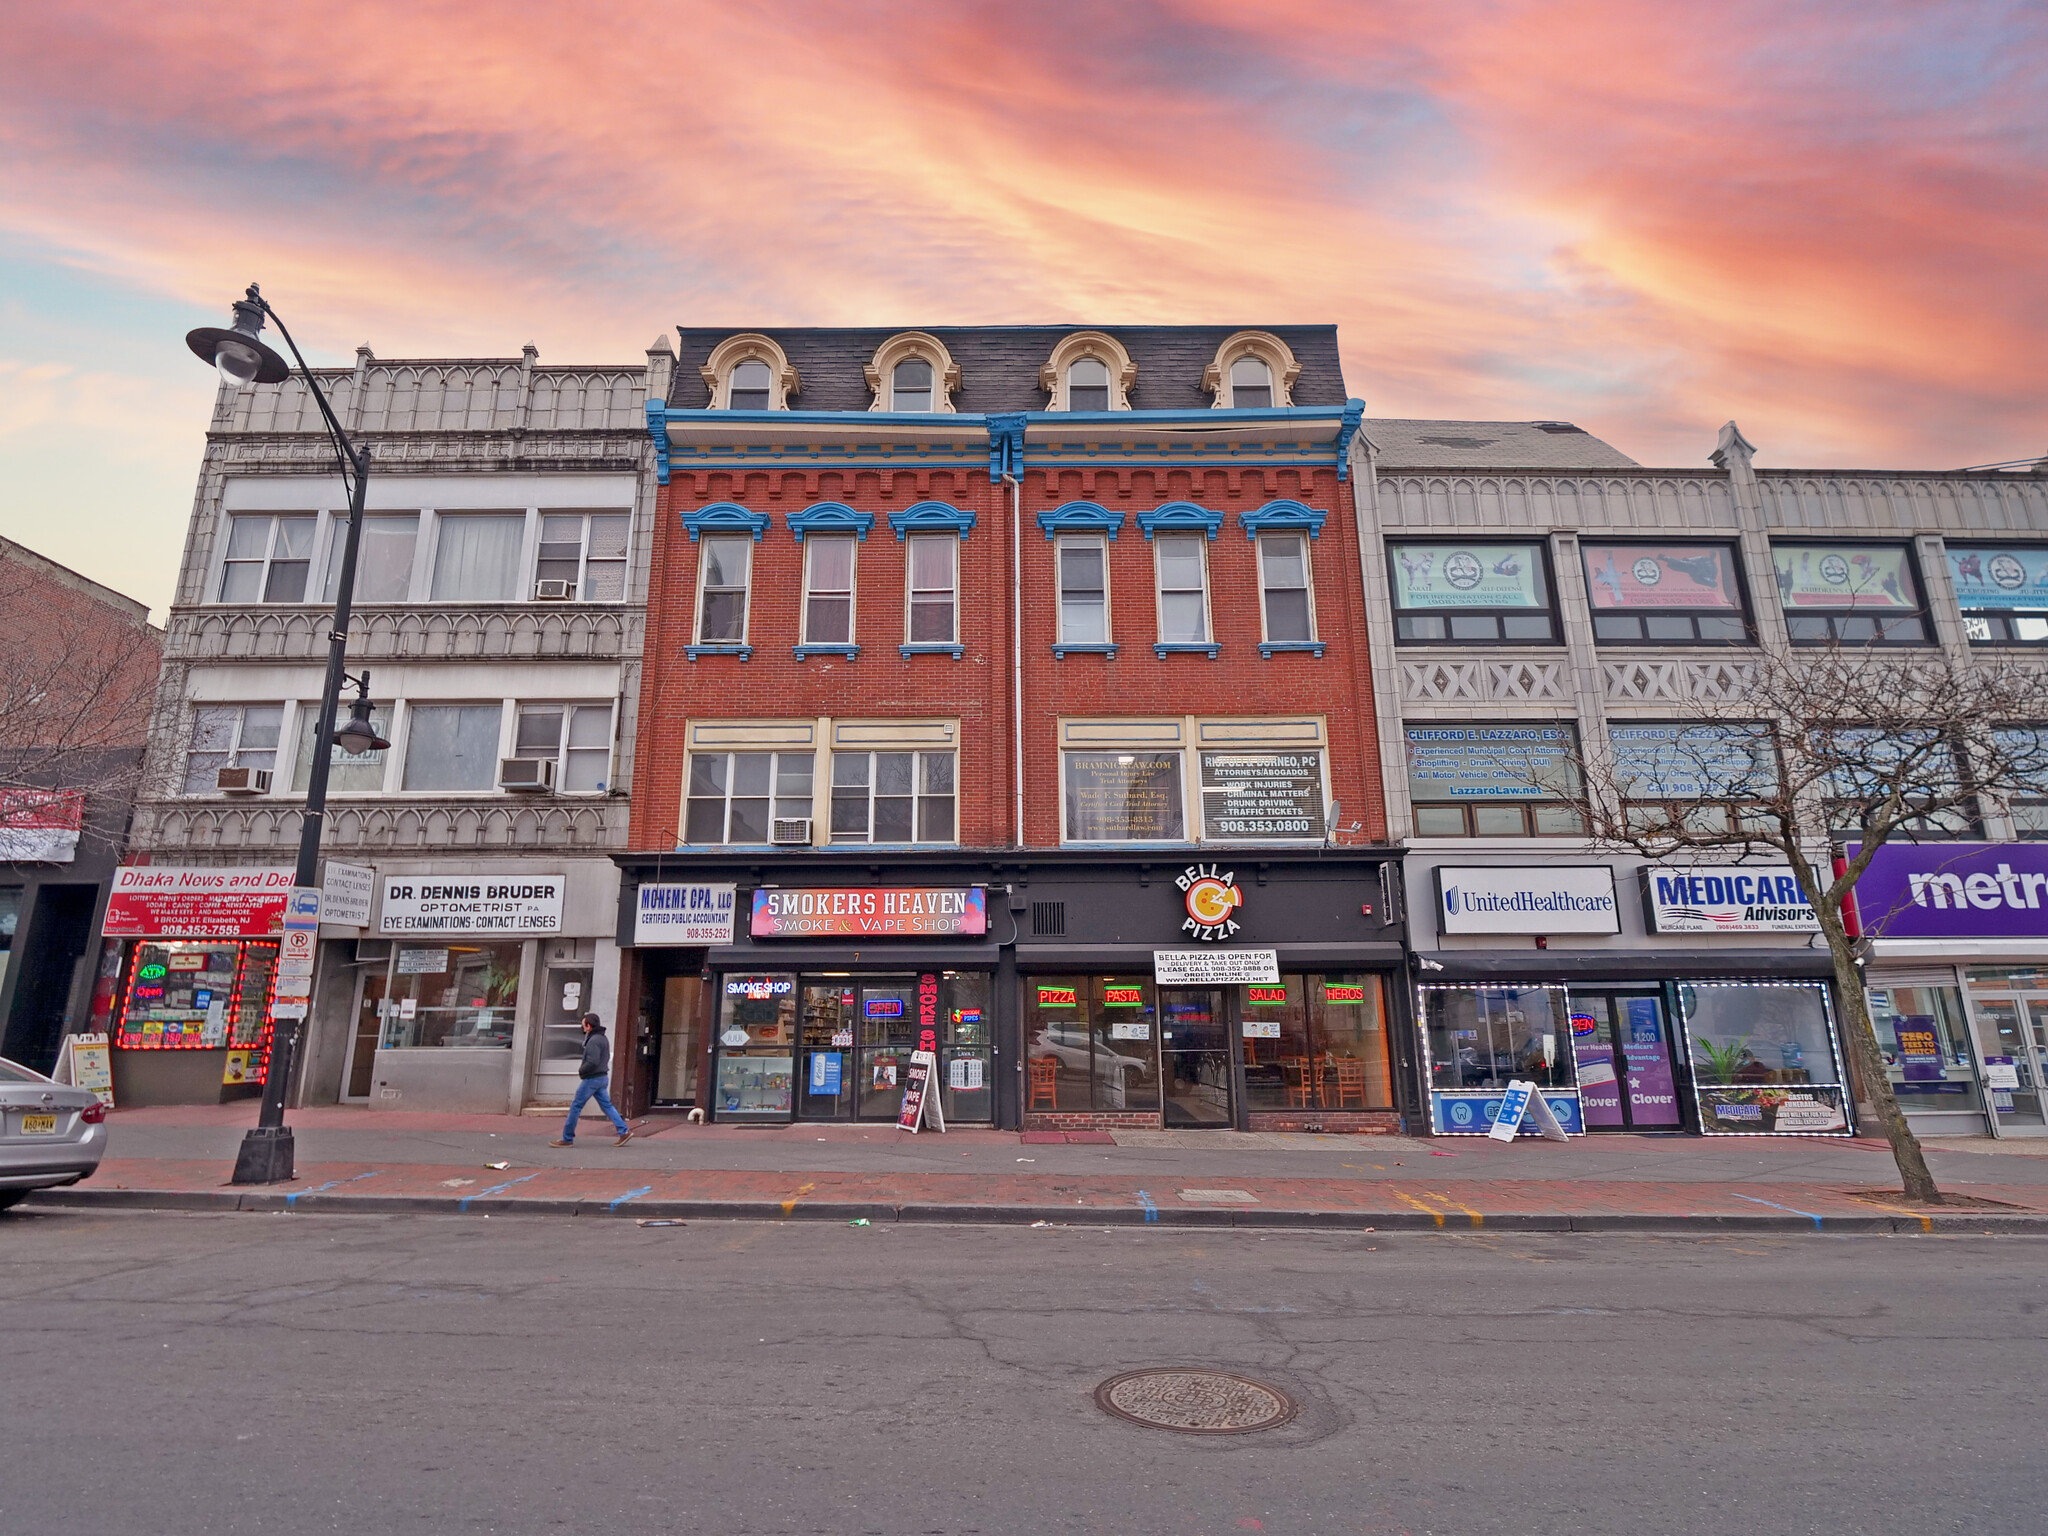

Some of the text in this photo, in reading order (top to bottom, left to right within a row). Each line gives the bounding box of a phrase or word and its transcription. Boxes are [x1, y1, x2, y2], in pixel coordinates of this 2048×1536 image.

[1408, 730, 1569, 741] CLIFFORD E. LAZZARO, ESQ.
[1611, 730, 1666, 739] CLIFFORD
[1415, 747, 1568, 756] Experienced Municipal Court Attorney
[1302, 756, 1316, 767] PC
[1416, 759, 1551, 768] Shoplifting Drunk Driving (DUI)
[1449, 786, 1543, 796] LazzaroLaw.net
[1647, 783, 1669, 792] Call
[1150, 791, 1168, 800] Esq.
[1227, 790, 1268, 798] CRIMINAL
[1227, 799, 1294, 807] DRUNK DRIVING
[1220, 820, 1309, 832] 908.353.0800
[120, 872, 264, 887] Dhaka News and
[1175, 863, 1235, 892] BELLA
[326, 878, 372, 892] CONTACT LENSES
[1908, 863, 2048, 910] metr
[390, 885, 556, 900] DR. DENNIS BRUDER
[640, 888, 732, 912] MONEME CPA, LLC
[768, 892, 967, 915] SMOKERS HEAVEN
[1463, 891, 1613, 912] UnitedHealthcare
[420, 903, 523, 913] OPTOMETRIST
[1744, 907, 1815, 921] Advisors
[202, 916, 238, 925] Elizabeth,
[240, 916, 251, 924] NJ
[324, 909, 366, 920] OPTOMETRIST
[641, 913, 729, 924] CERTIFIED PUBLIC ACCOUNTANT
[384, 915, 557, 929] EYE LENSES
[773, 917, 962, 932] SMOKE & VAPE SHOP
[686, 928, 731, 939] 908-355-2521
[1182, 917, 1241, 941] PIZZA
[853, 952, 860, 962] 7
[139, 965, 167, 977] ATM
[136, 986, 164, 997] Open
[727, 981, 791, 994] SMOKE SHOP
[919, 974, 938, 1025] SMOKE
[1040, 991, 1076, 1003] PIZZA
[1106, 990, 1140, 1002] PASTA
[1249, 988, 1286, 1001] SALAD
[1326, 988, 1364, 1000] HEROS
[868, 1002, 900, 1014] OPEN
[1573, 1018, 1595, 1031] PEN
[1901, 1031, 1934, 1041] ZERO
[908, 1068, 927, 1080] SMOKE
[905, 1091, 921, 1102] VAPE
[1631, 1093, 1673, 1104] Clover
[902, 1103, 918, 1115] SHOP
[1715, 1104, 1761, 1116] MEDICARE
